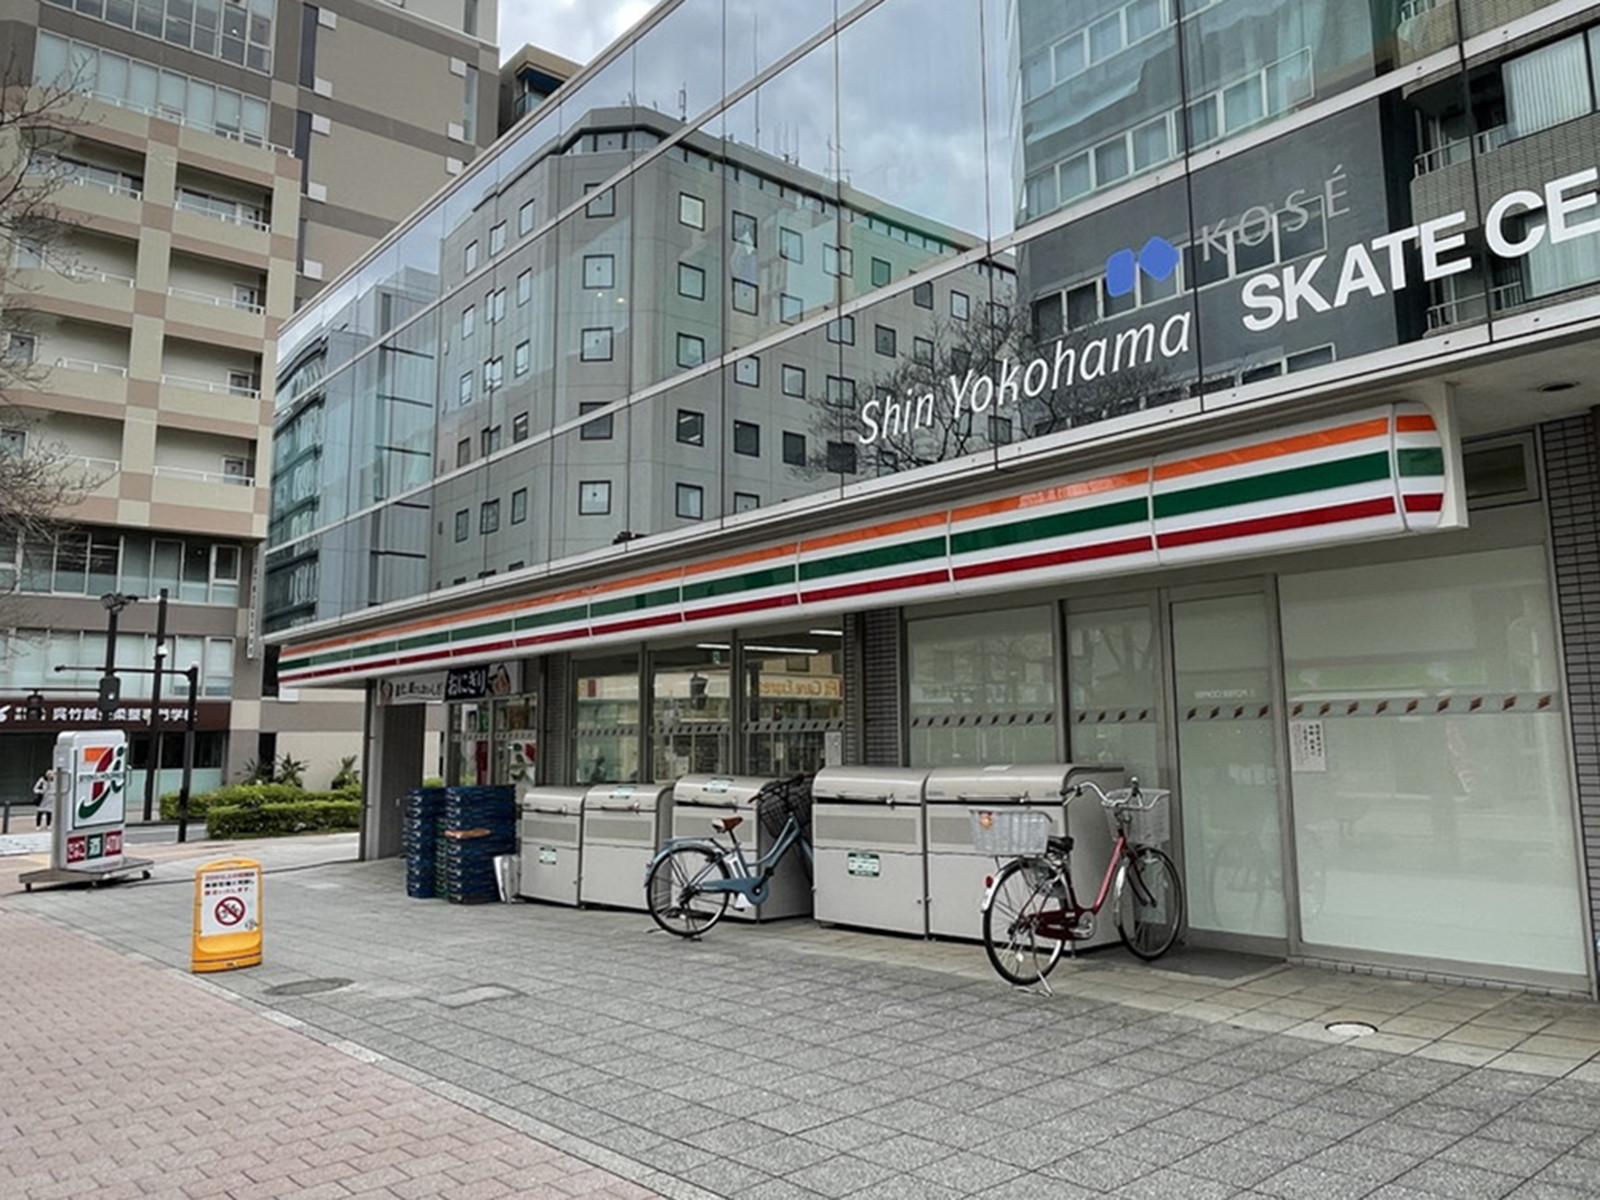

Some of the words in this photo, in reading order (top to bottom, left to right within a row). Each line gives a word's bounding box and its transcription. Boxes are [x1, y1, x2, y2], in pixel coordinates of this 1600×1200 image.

[1200, 165, 1351, 262] KOSÉ
[1242, 211, 1473, 332] SKATE
[859, 387, 936, 446] Shin
[949, 310, 1193, 421] Yokohama
[446, 668, 487, 697] おにぎり
